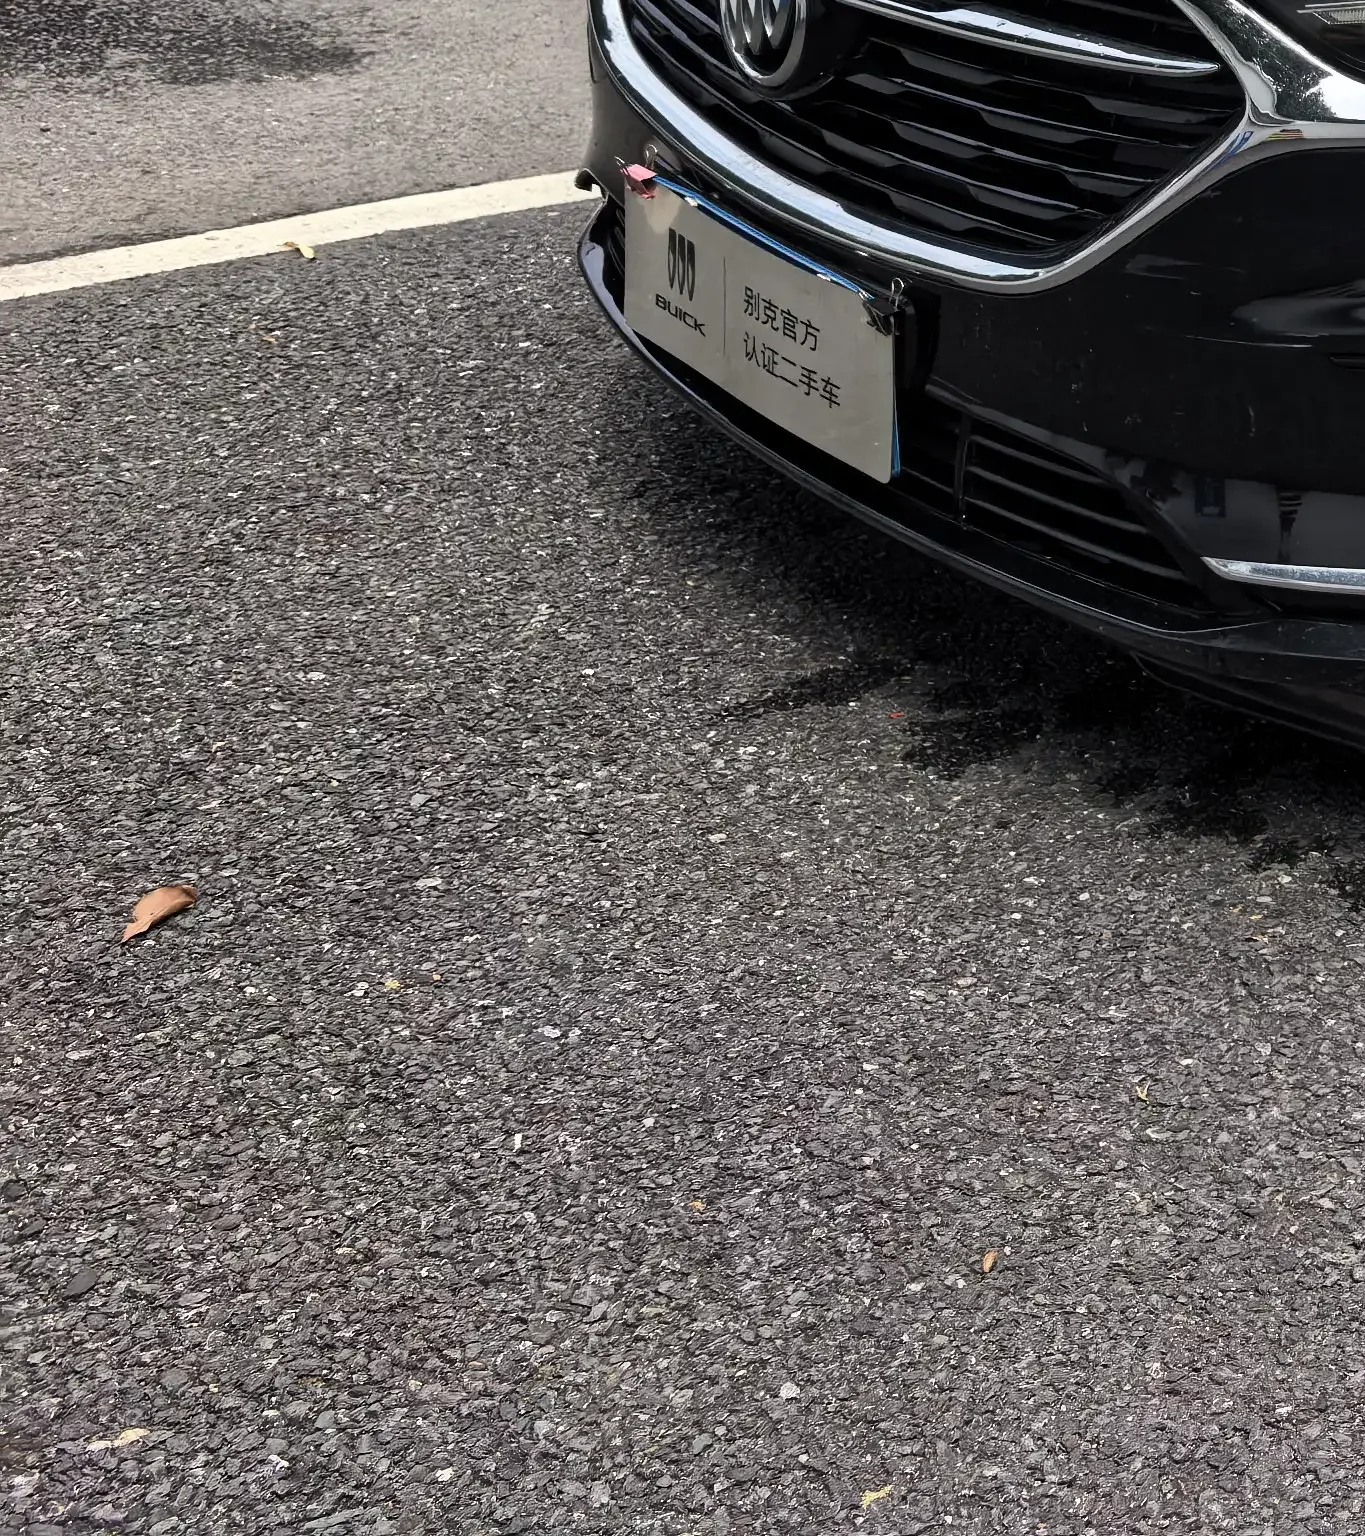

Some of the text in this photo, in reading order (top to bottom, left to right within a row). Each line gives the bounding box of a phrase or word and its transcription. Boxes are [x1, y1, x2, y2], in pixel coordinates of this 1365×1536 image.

[655, 293, 707, 337] BUICK
[743, 286, 820, 351] 别克官方
[743, 331, 841, 408] 认证二手车
